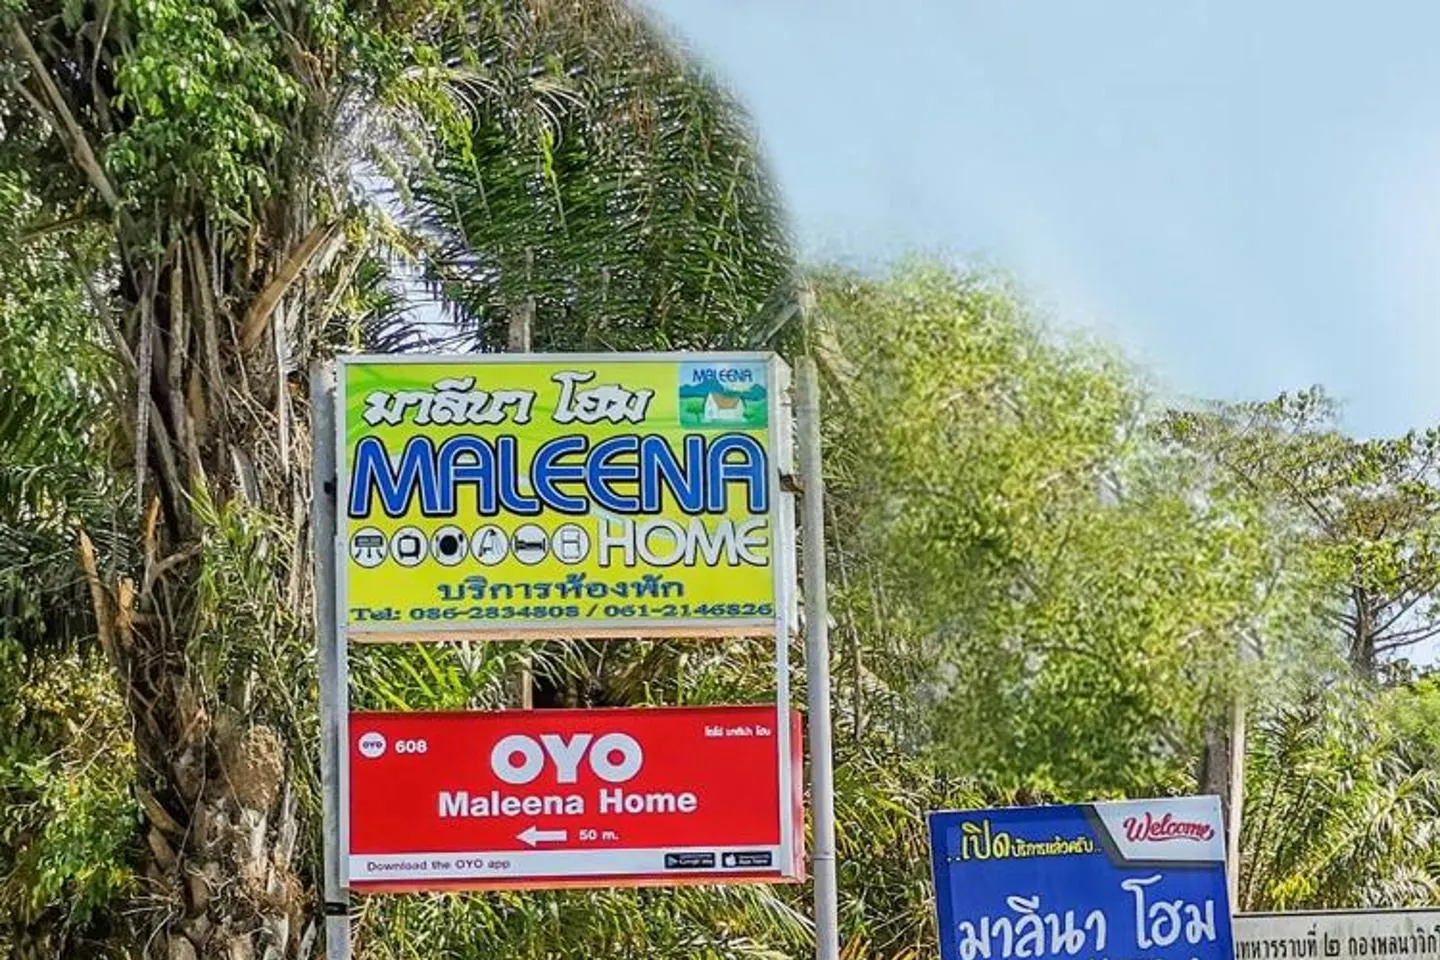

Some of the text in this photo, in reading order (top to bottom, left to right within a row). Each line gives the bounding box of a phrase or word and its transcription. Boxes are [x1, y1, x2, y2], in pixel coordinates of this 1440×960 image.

[692, 368, 753, 383] MALEENA
[362, 371, 655, 426] มาลีนา โฮม
[348, 434, 769, 517] MALEENA
[598, 516, 769, 568] HOME
[437, 573, 685, 601] บริการห้องพัก
[395, 739, 428, 754] 608
[491, 733, 644, 785] OYO
[439, 788, 698, 818] Maleena Home
[579, 829, 619, 842] 50 m.
[1123, 812, 1215, 841] Welcome
[366, 859, 511, 872] Download the OYO app
[1121, 875, 1217, 949] โฮม
[1236, 923, 1316, 960] ทหารราบที่
